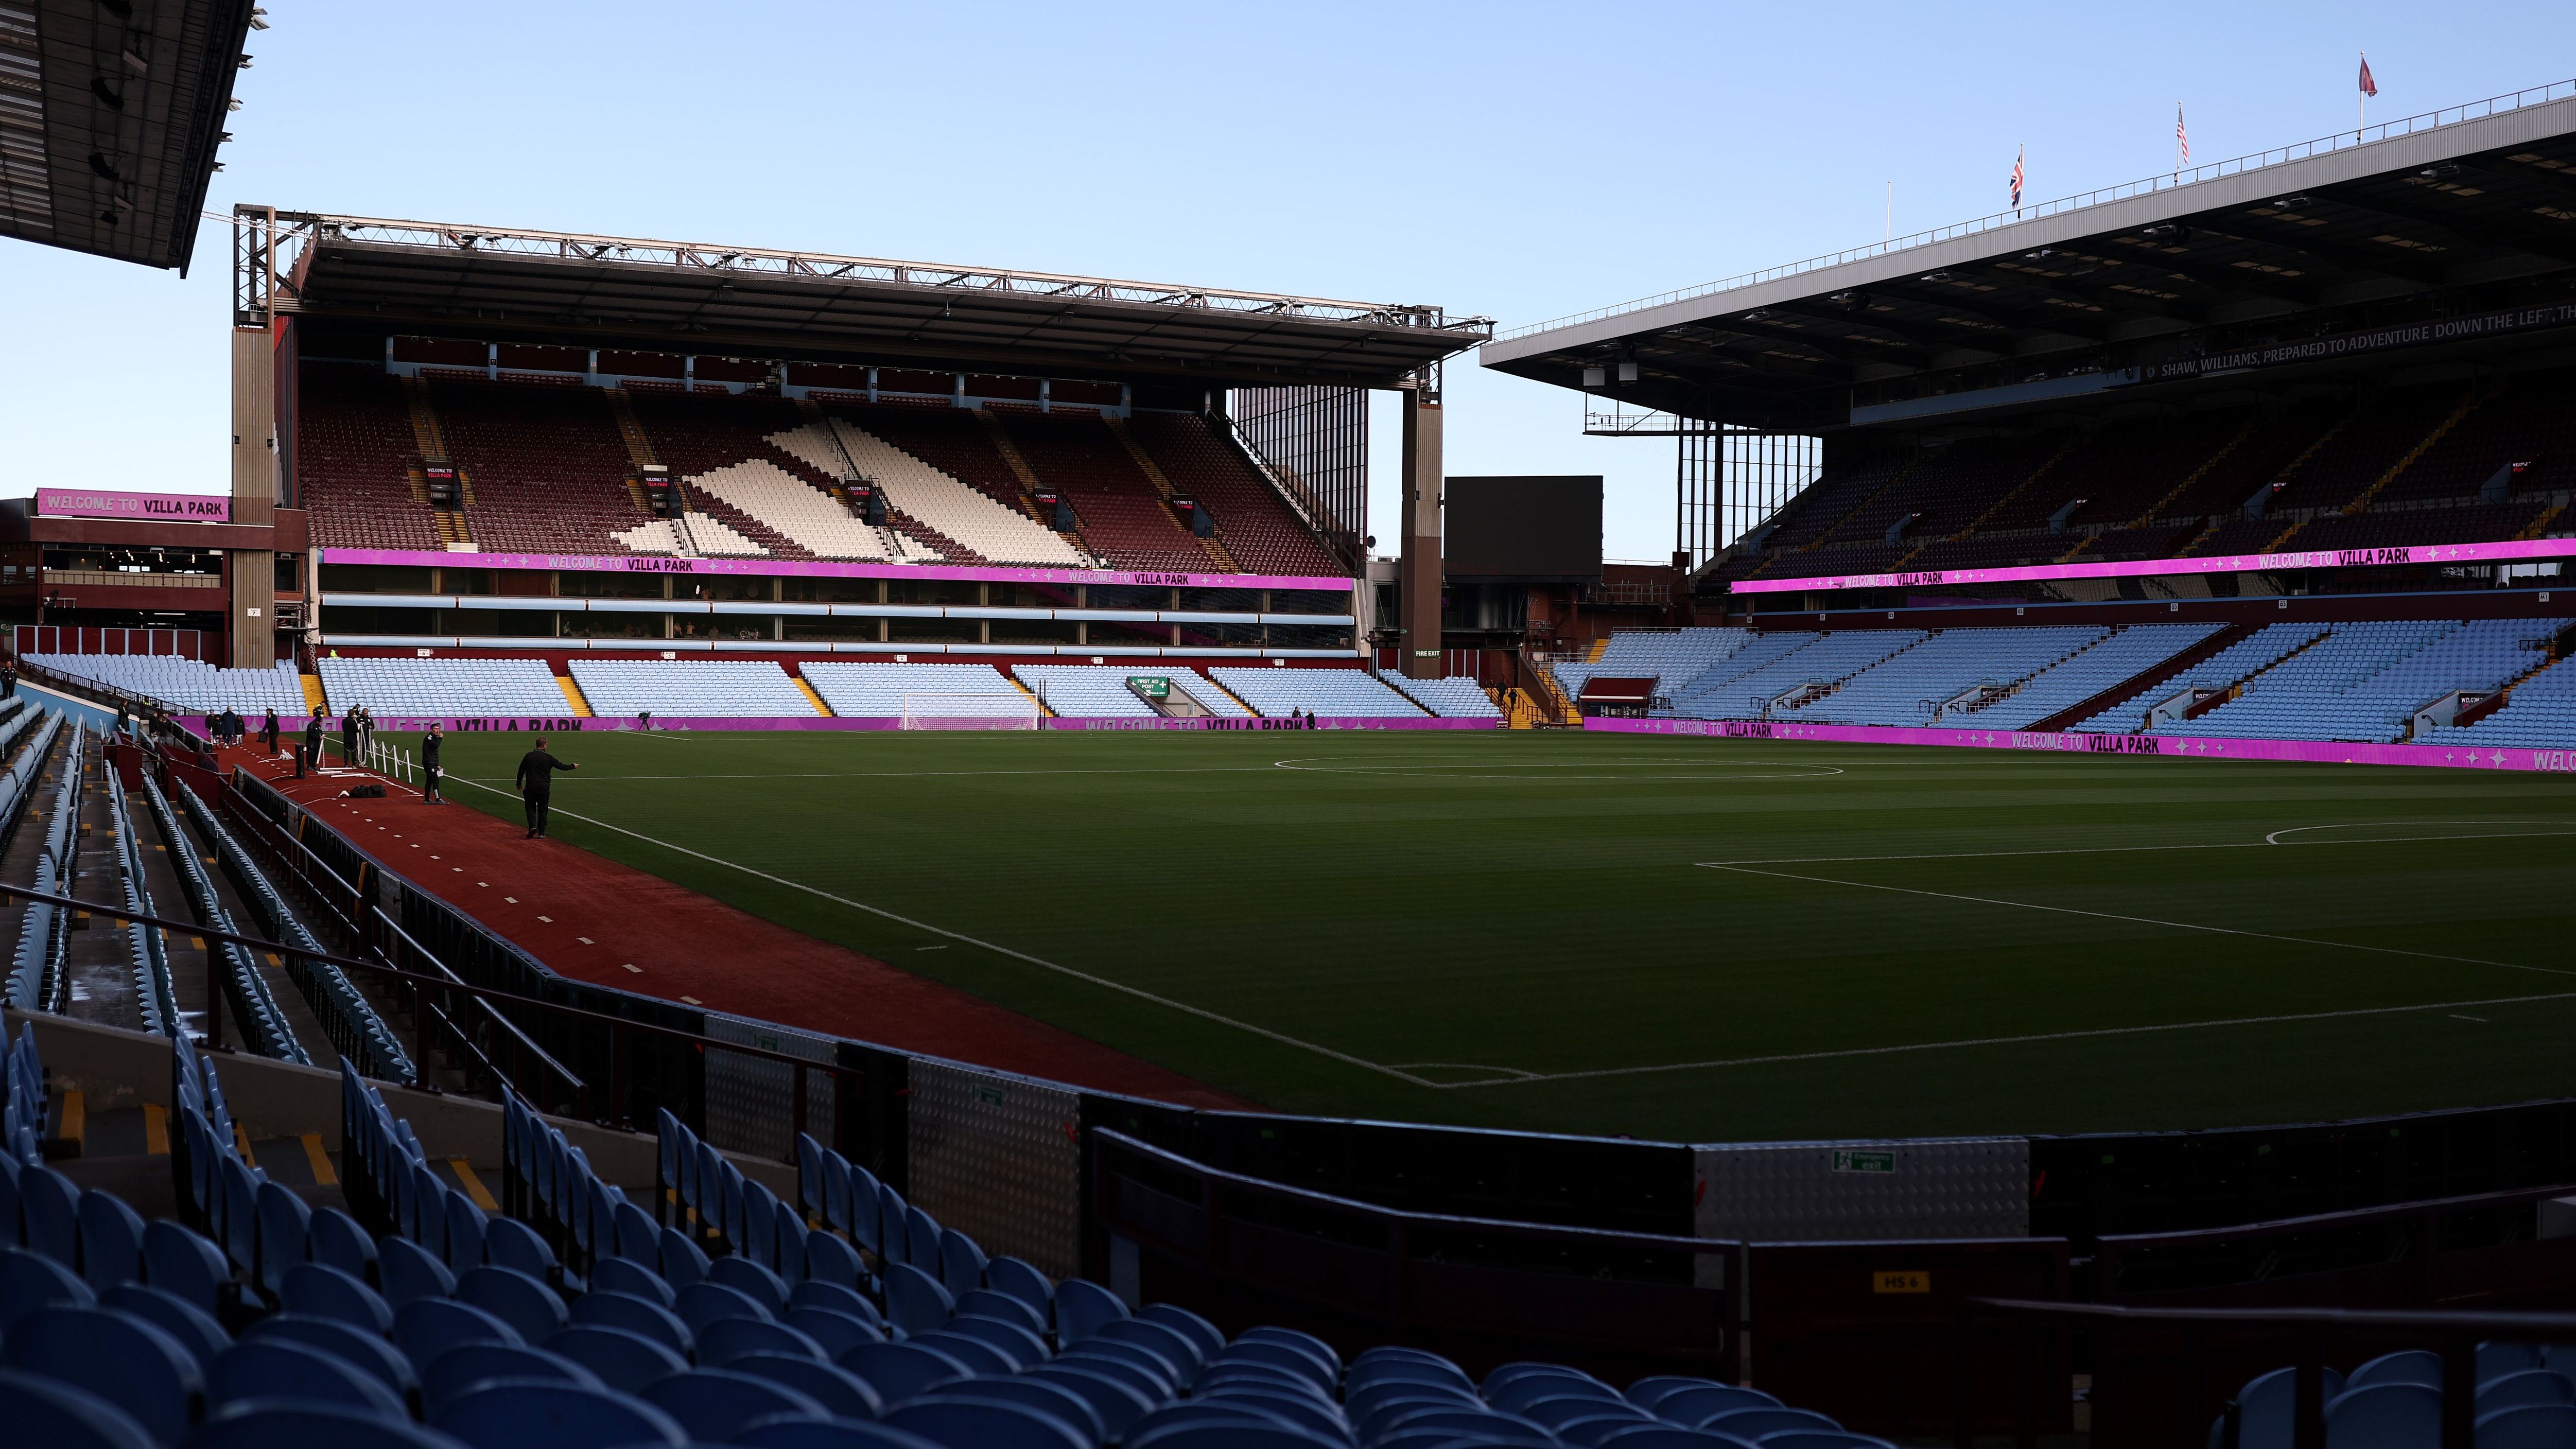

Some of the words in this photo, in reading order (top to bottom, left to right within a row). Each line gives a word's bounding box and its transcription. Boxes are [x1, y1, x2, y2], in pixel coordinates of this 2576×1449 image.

[2162, 360, 2198, 376] SHAW,
[2200, 352, 2260, 371] WILLIAMS,
[2264, 342, 2325, 362] PREPARED
[2329, 339, 2346, 353] TO
[2348, 326, 2429, 351] ADVENTURE
[2435, 319, 2481, 338] DOWN
[2485, 313, 2513, 330] THE
[47, 495, 113, 511] WELCOME
[118, 498, 137, 512] TO
[144, 500, 183, 514] VILLA
[188, 502, 222, 515] PARK
[548, 557, 602, 569] WELCOME
[606, 558, 622, 570] TO
[628, 559, 660, 570] VILLA
[665, 560, 693, 571] PARK
[2259, 552, 2313, 569] WELCOME
[2317, 551, 2333, 566] TO
[2339, 550, 2374, 565] VILLA
[2378, 548, 2410, 563] PARK
[1069, 571, 1114, 583] WELCOME
[1117, 573, 1130, 583] TO
[1134, 573, 1161, 584] VILLA
[1165, 574, 1189, 585] PARK
[1845, 575, 1880, 588] WELCOME
[1883, 574, 1893, 586] TO
[1897, 573, 1920, 585] VILLA
[1923, 572, 1943, 584] PARK
[298, 719, 407, 731] WELME
[456, 719, 518, 731] VILLA
[529, 719, 582, 731] PARK
[1085, 719, 1169, 730] WELCOME
[1174, 719, 1198, 730] TO
[1206, 719, 1254, 730] VILLA
[1262, 719, 1302, 730] PARK
[1673, 721, 1708, 735] WELCOME
[1710, 722, 1721, 735] TO
[1725, 723, 1748, 737] VILLA
[1751, 724, 1772, 737] PARK
[2012, 733, 2064, 749] WELCOME
[2067, 735, 2083, 750] TO
[2088, 736, 2124, 752] VILLA
[2128, 737, 2159, 754] PARK
[1853, 1152, 1890, 1162] Emergency
[1861, 1160, 1883, 1171] exit
[1885, 1277, 1905, 1288] HS
[1911, 1277, 1919, 1287] 6
